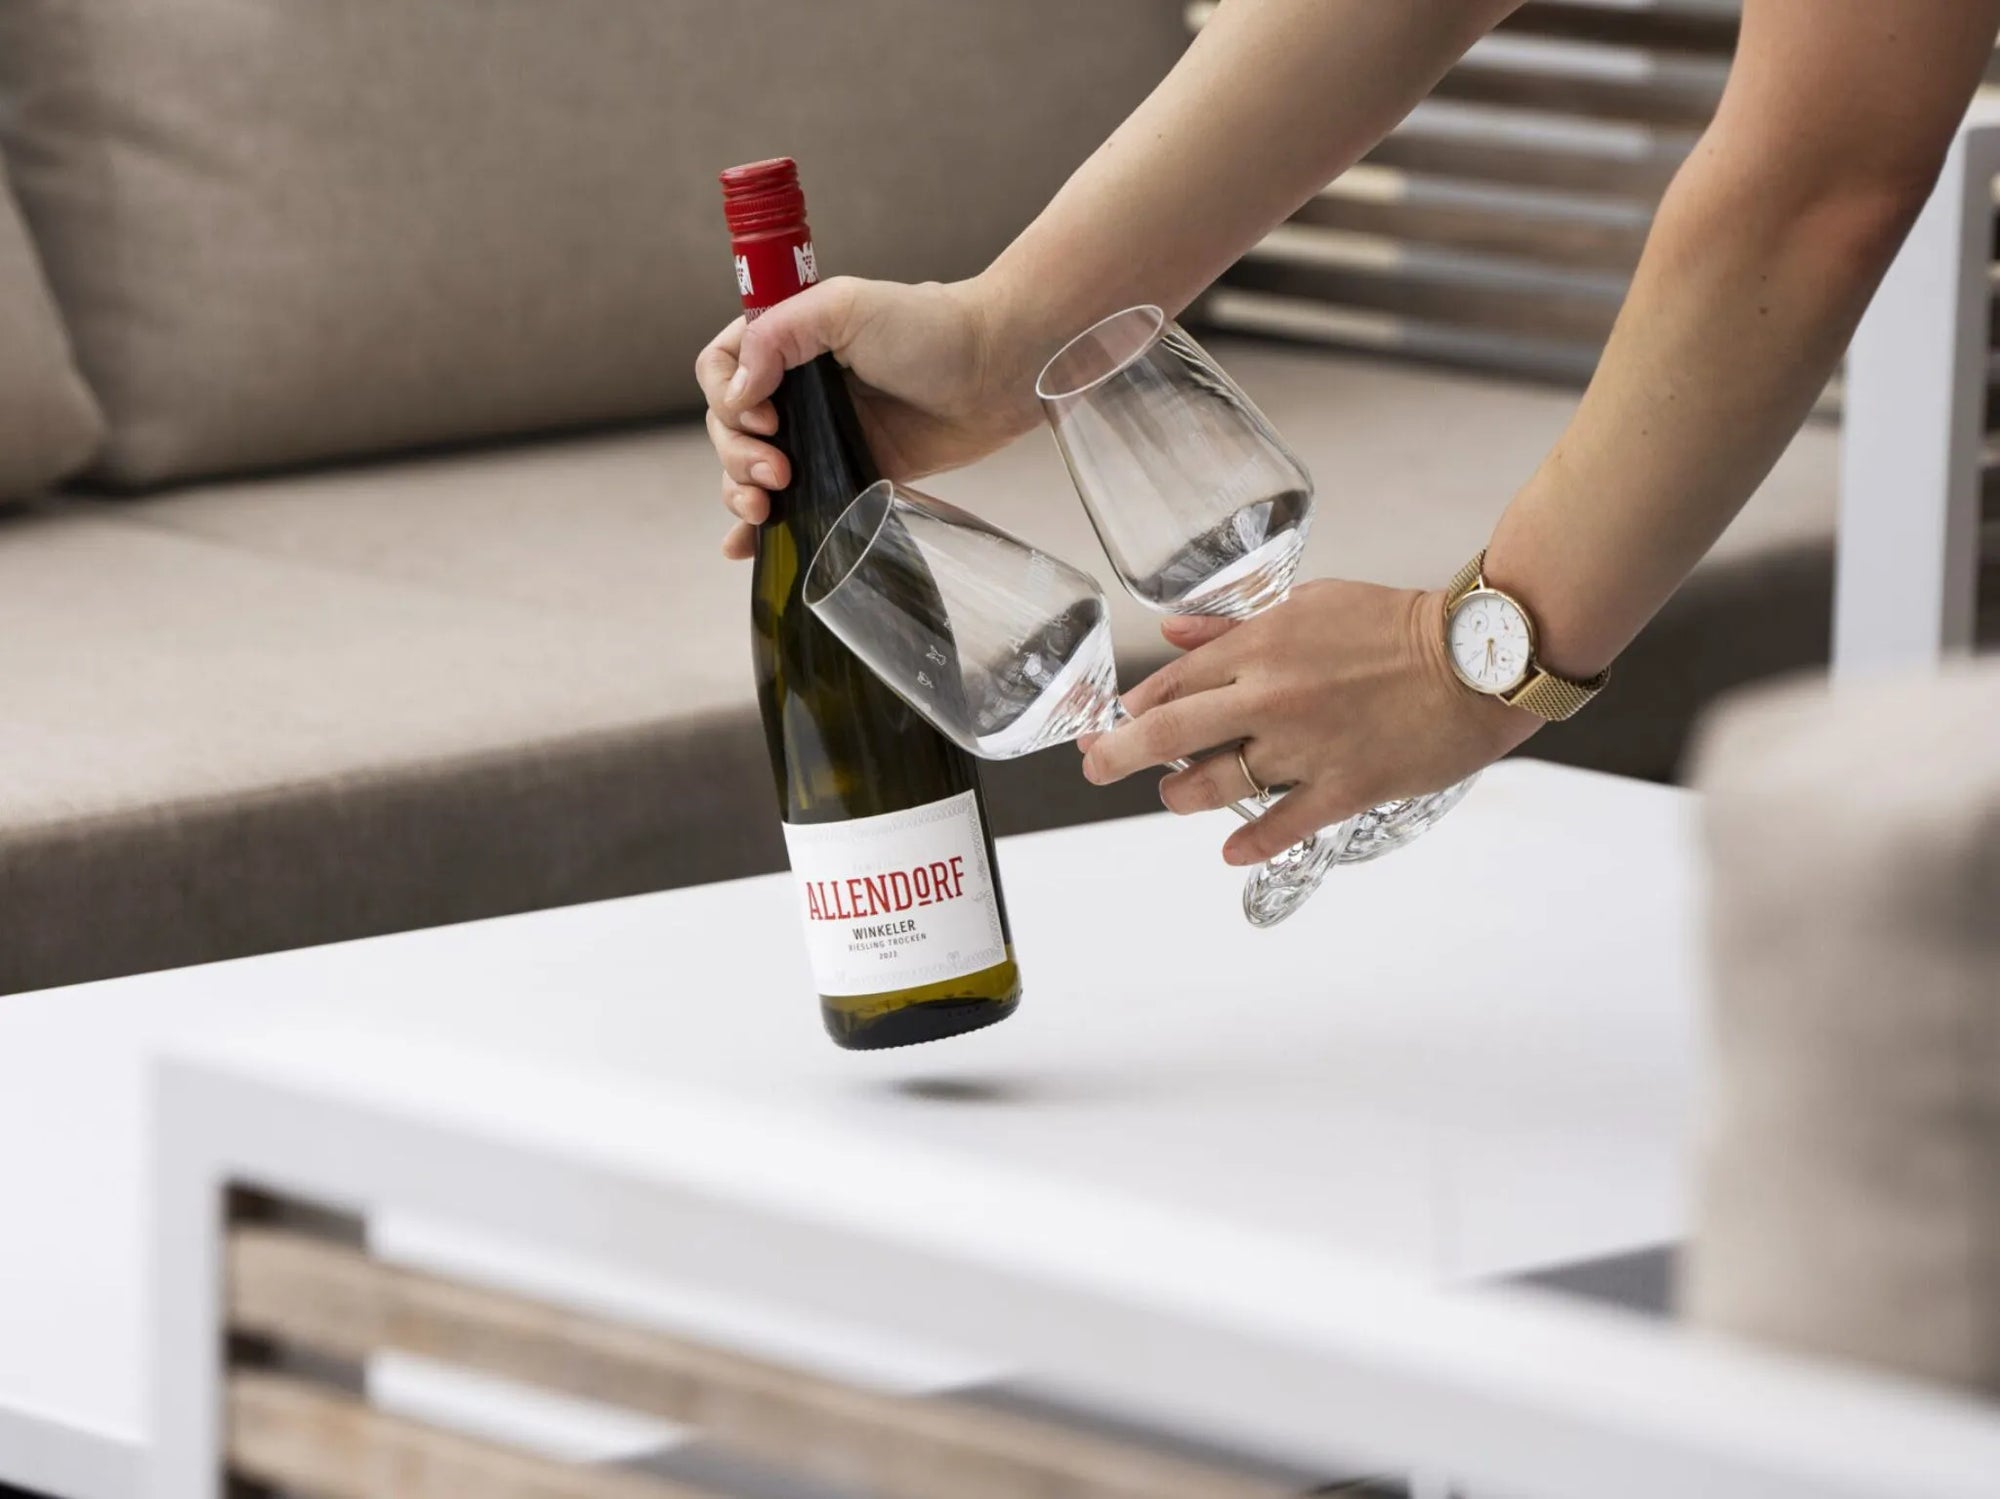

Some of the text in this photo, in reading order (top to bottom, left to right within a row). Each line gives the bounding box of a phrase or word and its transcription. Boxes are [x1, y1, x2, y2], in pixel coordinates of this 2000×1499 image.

[806, 855, 965, 921] ALLENDORF
[852, 919, 917, 940] WINKELER
[848, 932, 928, 952] RIESLING TROCKEN
